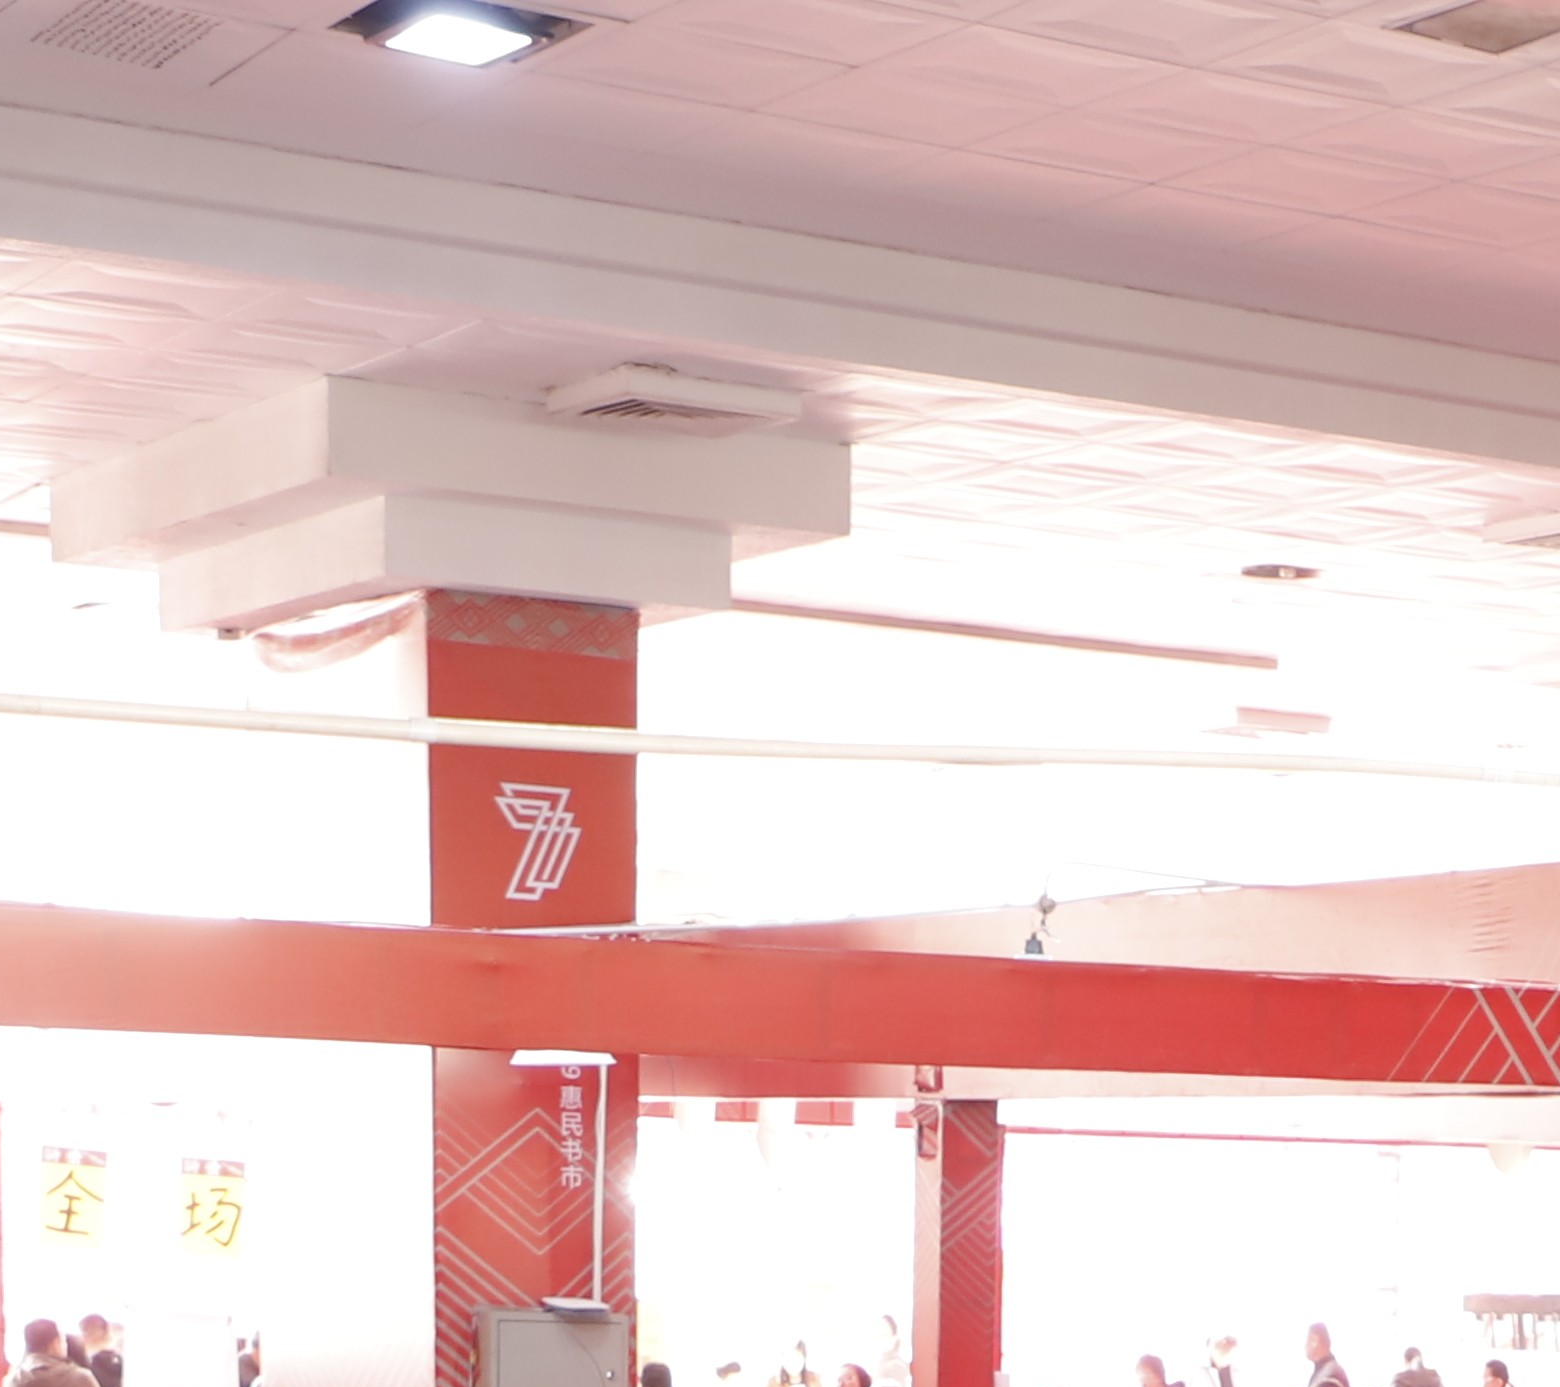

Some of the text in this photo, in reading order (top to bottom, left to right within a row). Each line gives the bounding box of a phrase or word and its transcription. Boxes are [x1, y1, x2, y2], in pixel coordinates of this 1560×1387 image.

[494, 782, 581, 901] 7
[46, 1170, 243, 1247] 全 场
